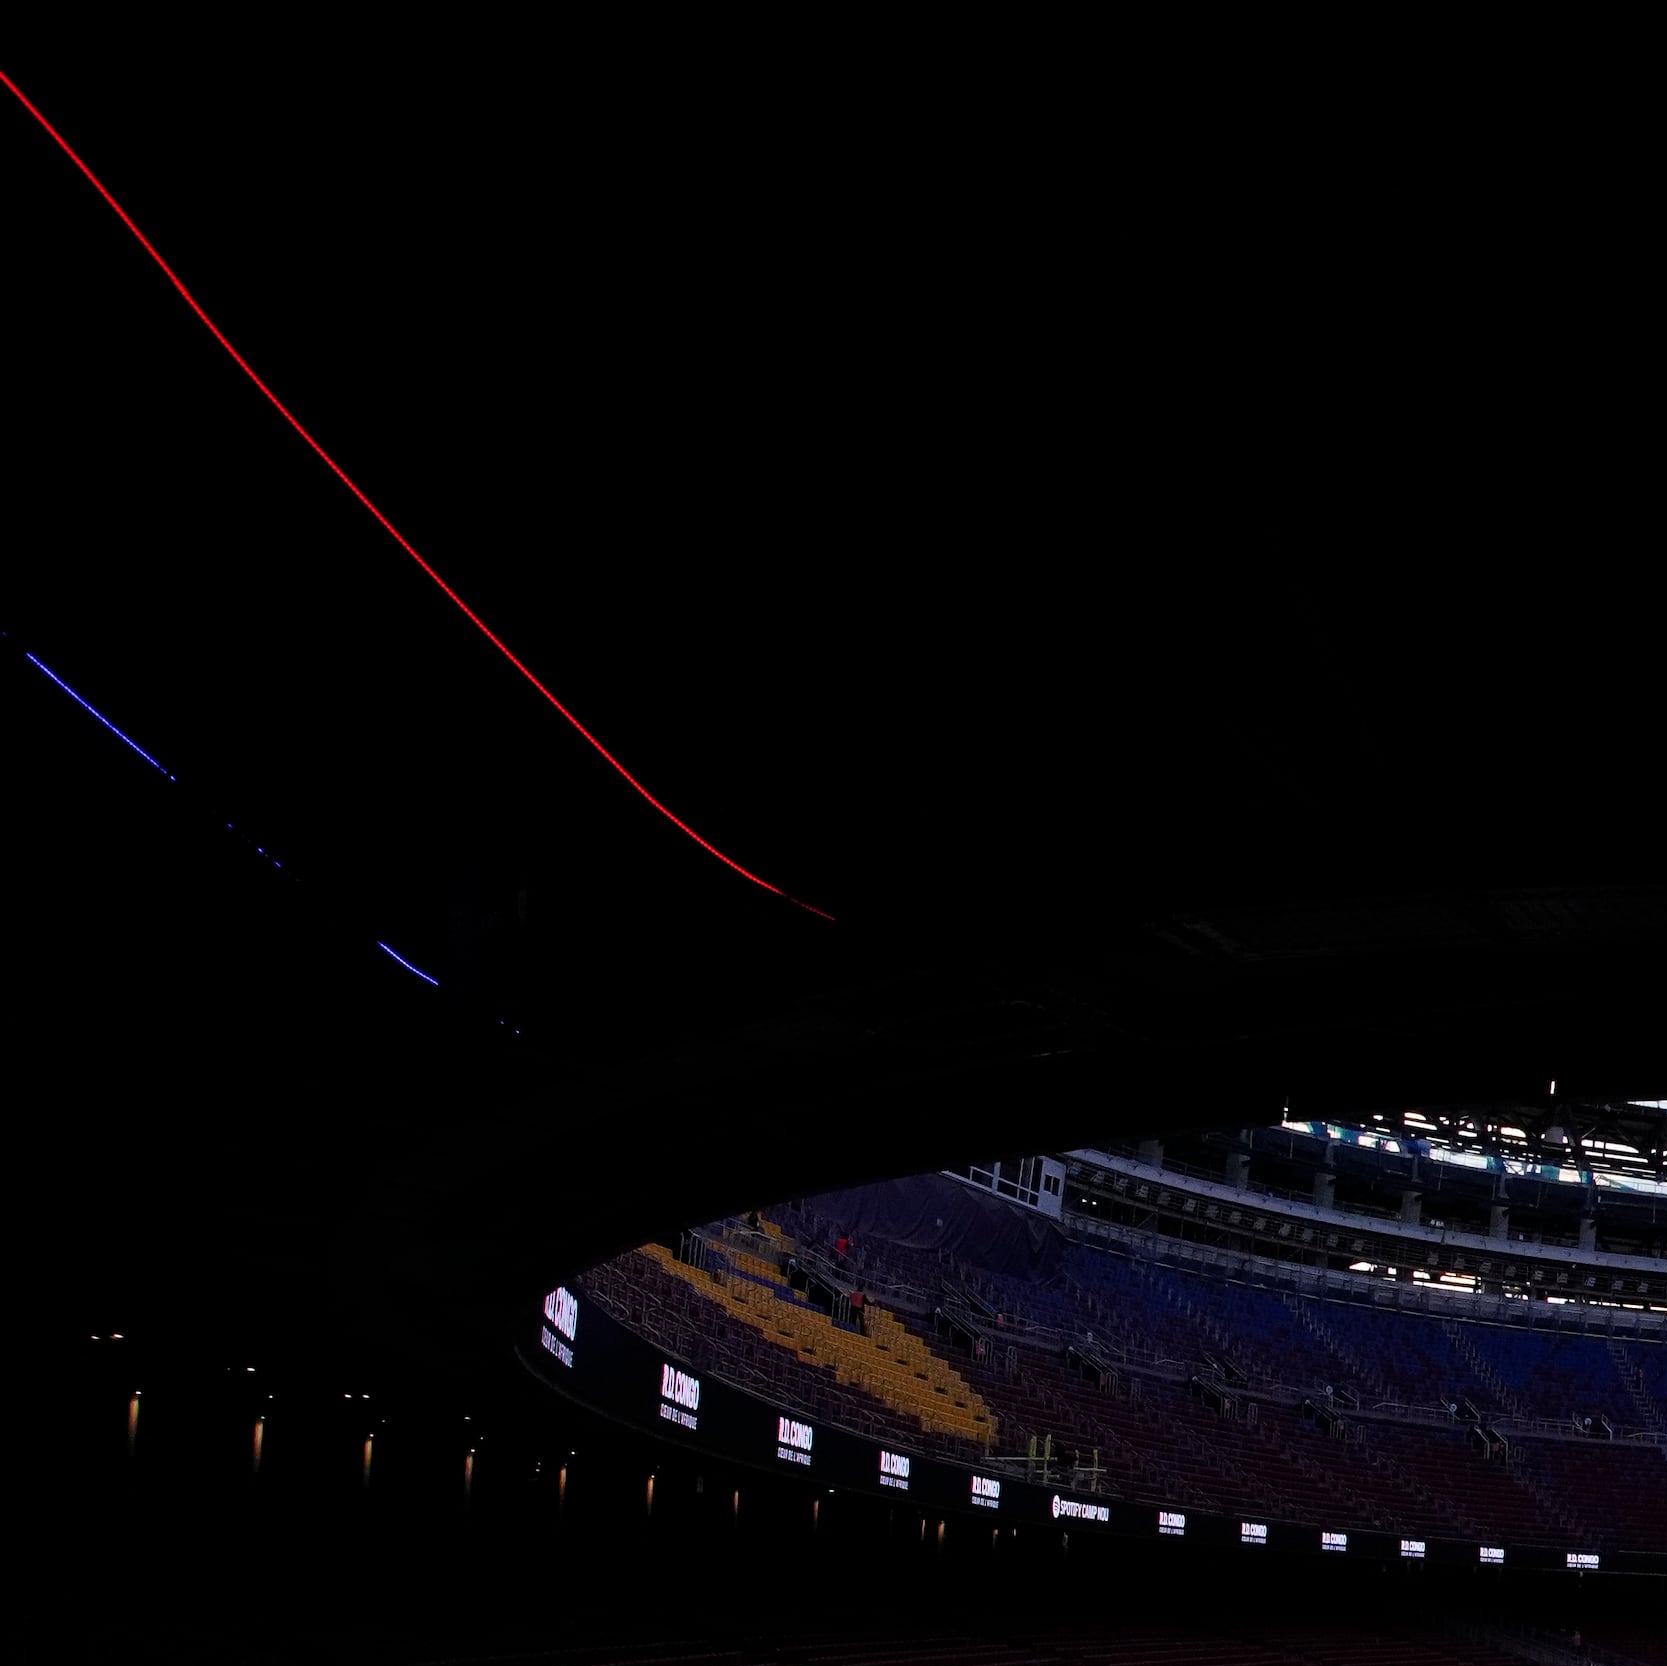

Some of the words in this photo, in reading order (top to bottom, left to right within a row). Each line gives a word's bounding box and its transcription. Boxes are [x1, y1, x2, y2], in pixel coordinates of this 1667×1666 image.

[675, 1371, 700, 1410] CONGO
[790, 1421, 813, 1451] CONGO
[890, 1453, 910, 1478] CONGO
[982, 1478, 1000, 1498] CONGO
[1060, 1500, 1082, 1517] SPOTIFY
[1082, 1504, 1097, 1520] CAMP
[1097, 1506, 1109, 1521] NOU
